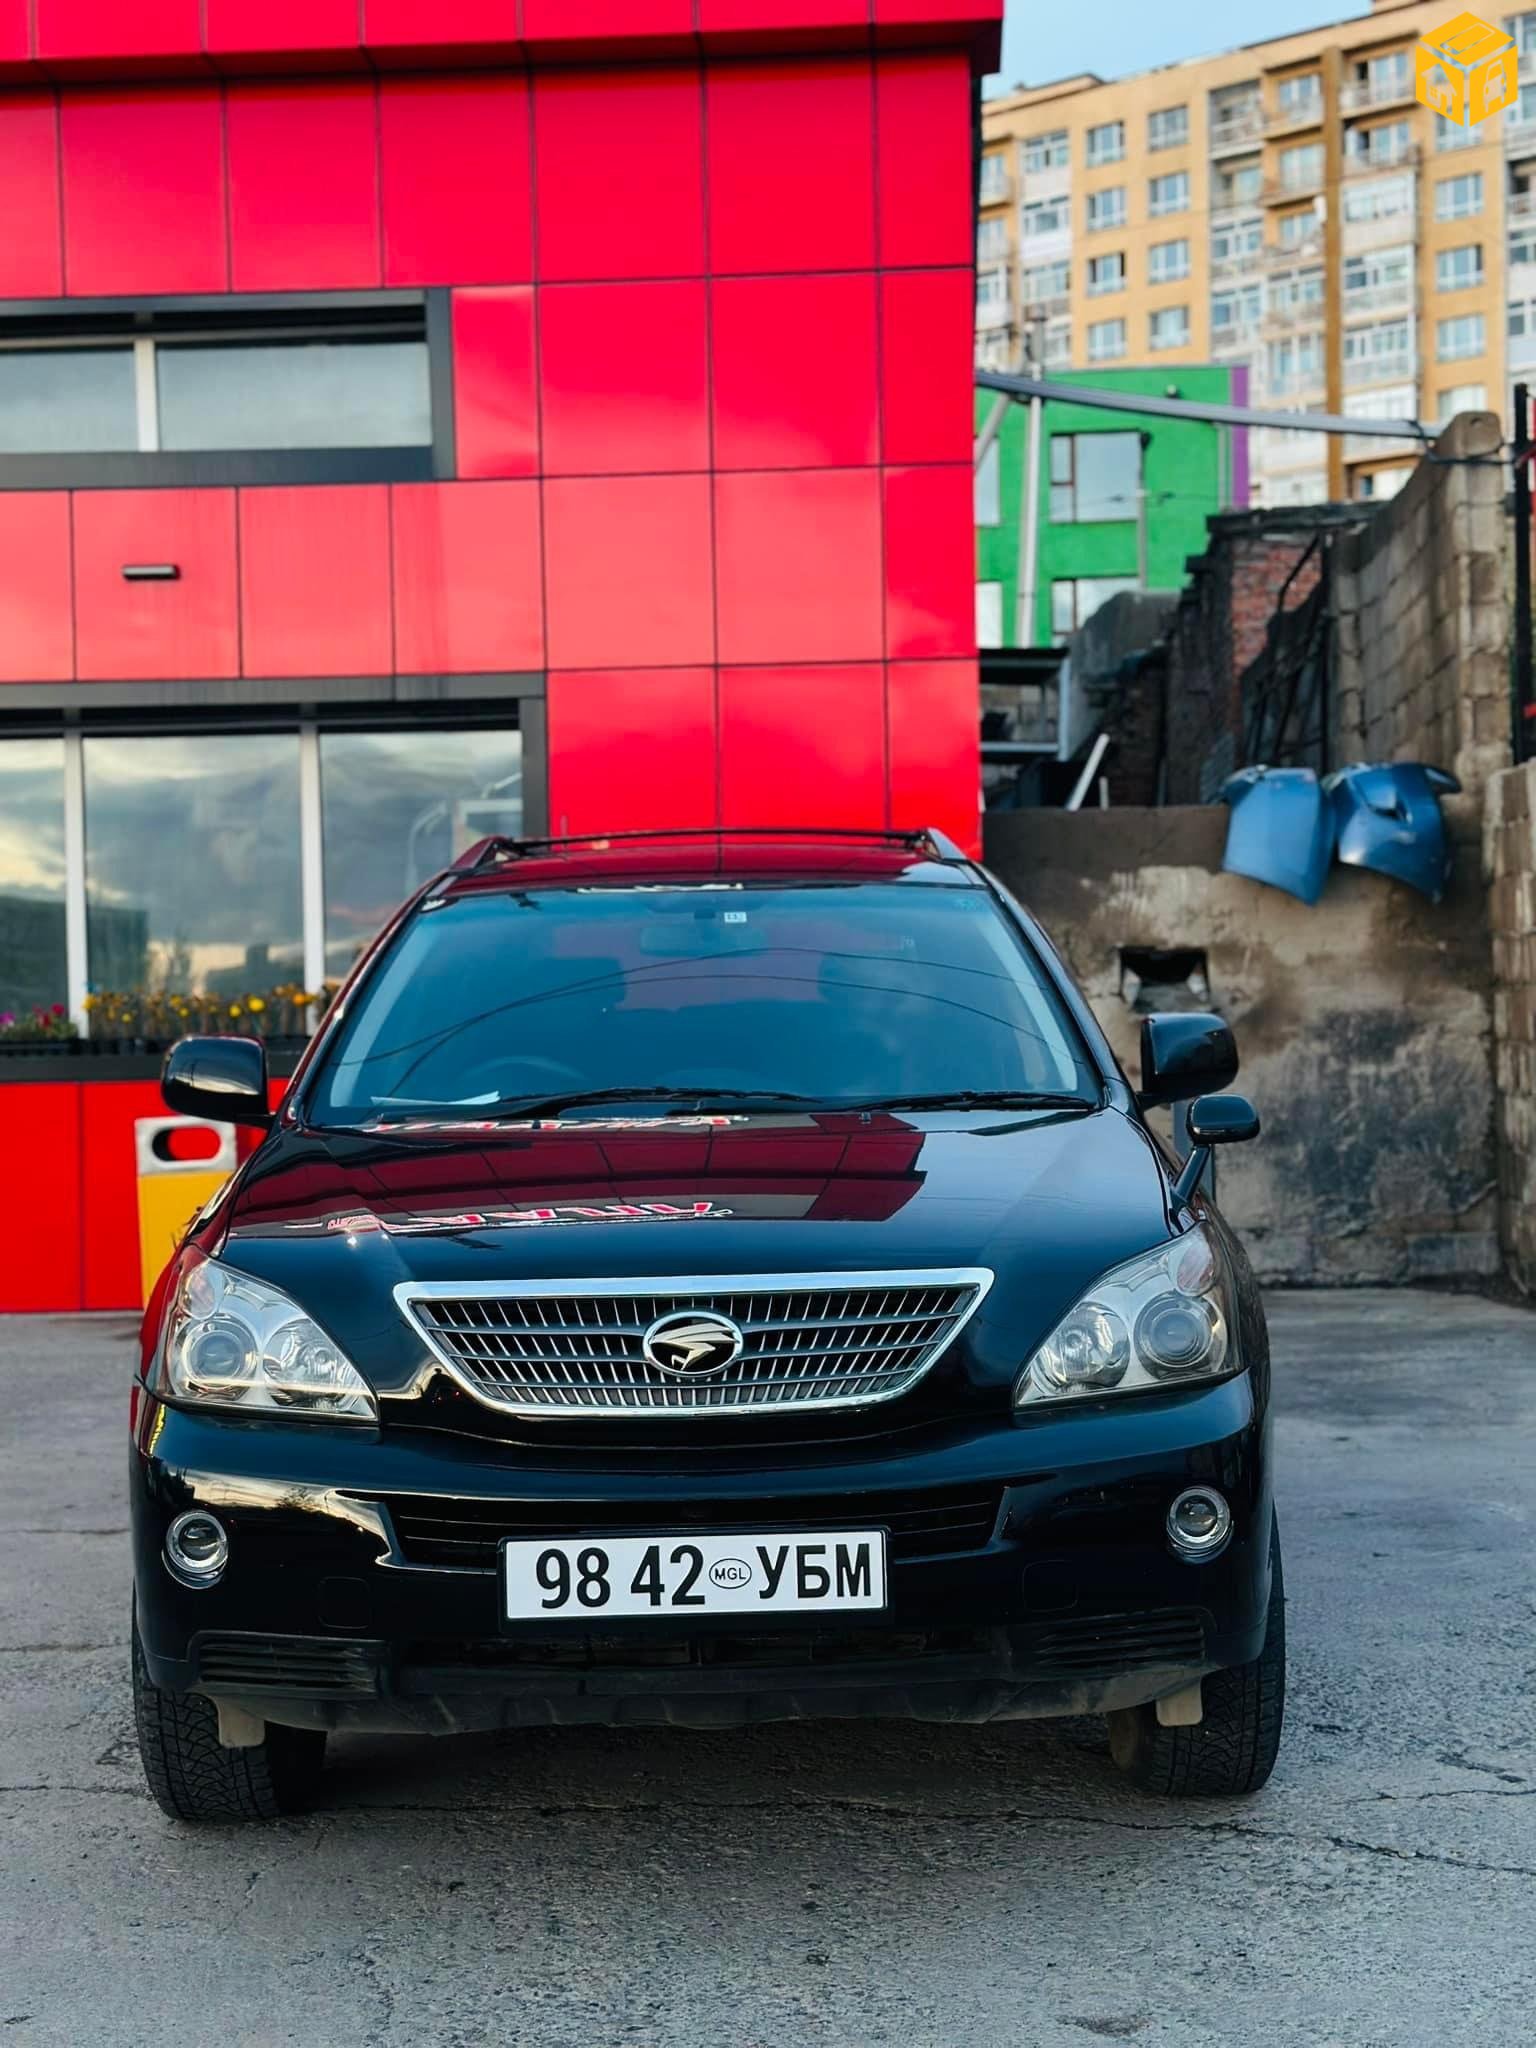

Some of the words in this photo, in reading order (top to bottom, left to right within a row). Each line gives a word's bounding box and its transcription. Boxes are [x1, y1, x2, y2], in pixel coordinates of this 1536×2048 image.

[535, 1547, 611, 1610] 98
[630, 1544, 706, 1607] 42
[714, 1567, 747, 1581] MGL
[755, 1542, 872, 1600] УБМ
